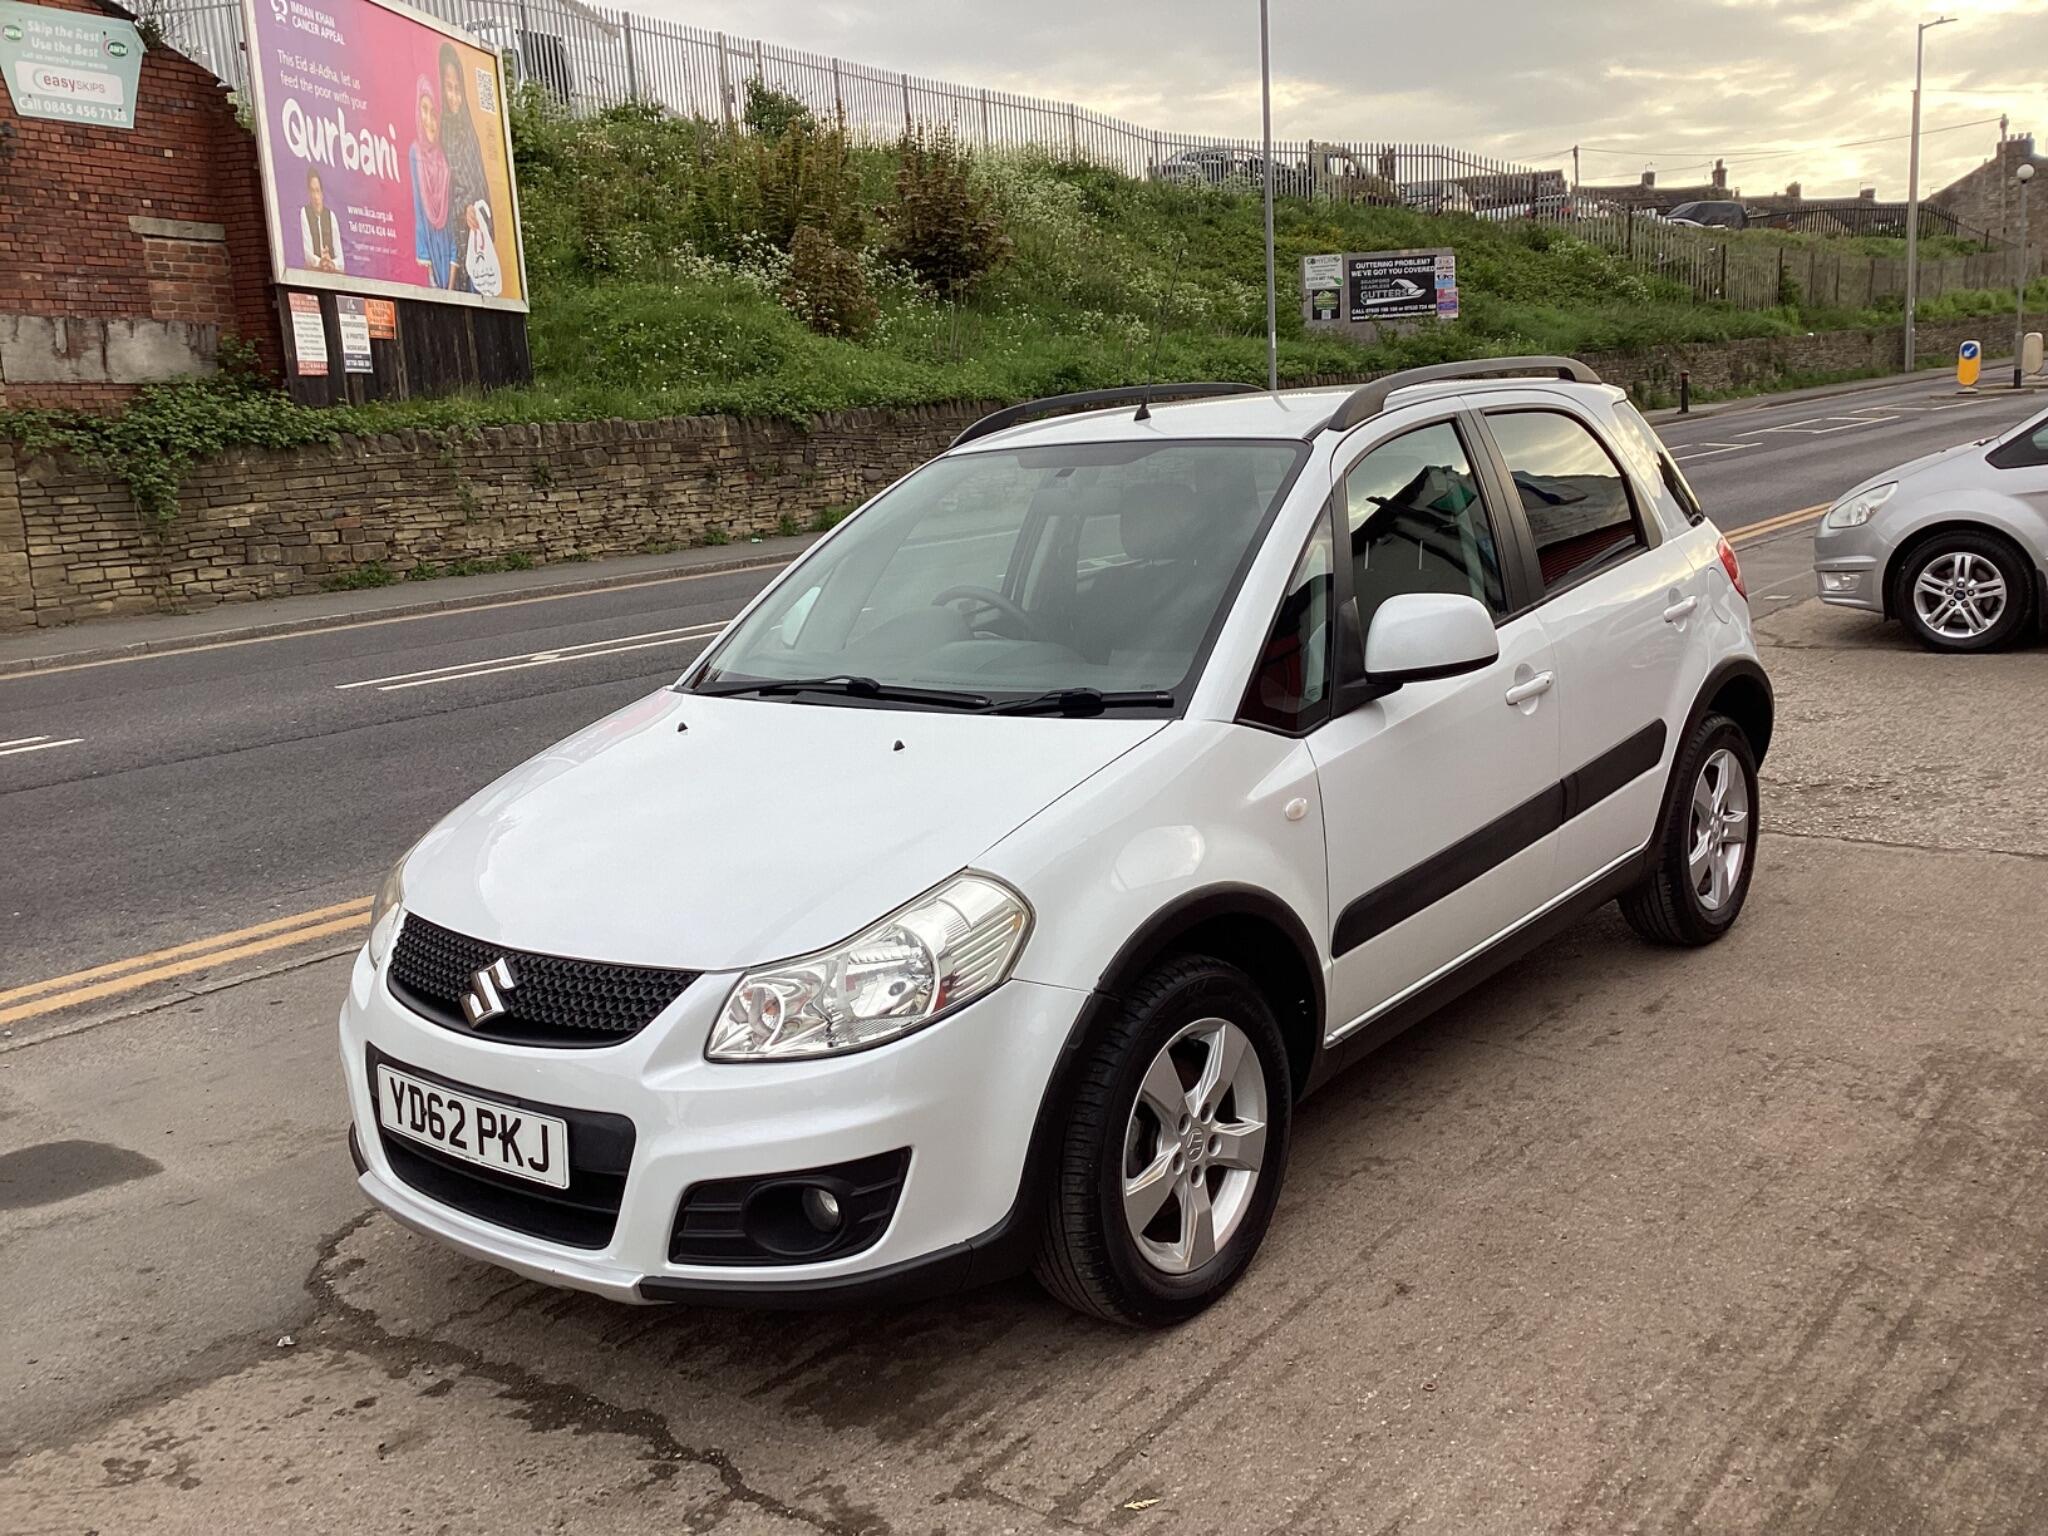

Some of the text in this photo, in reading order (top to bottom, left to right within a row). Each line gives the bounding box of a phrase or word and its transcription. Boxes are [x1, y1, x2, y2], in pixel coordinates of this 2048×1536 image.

[290, 1, 335, 28] IMRAN KHAN
[27, 20, 99, 43] Skip the Rest
[292, 16, 346, 45] CANCER APPEAL
[31, 36, 99, 58] Use the Best
[277, 49, 295, 67] This
[295, 55, 308, 72] Eid
[340, 71, 351, 87] let
[352, 79, 361, 90] us
[280, 70, 368, 110] feed the poor with your
[19, 97, 128, 121] Call 0845 456 7128
[282, 98, 400, 183] Qurbani
[1351, 264, 1436, 277] WE'VE GOT YOU COVERED
[1355, 258, 1430, 270] GUTTERING PROBLEM?
[1360, 289, 1408, 300] GUTTERS
[389, 1077, 549, 1173] YD62 PKJ
